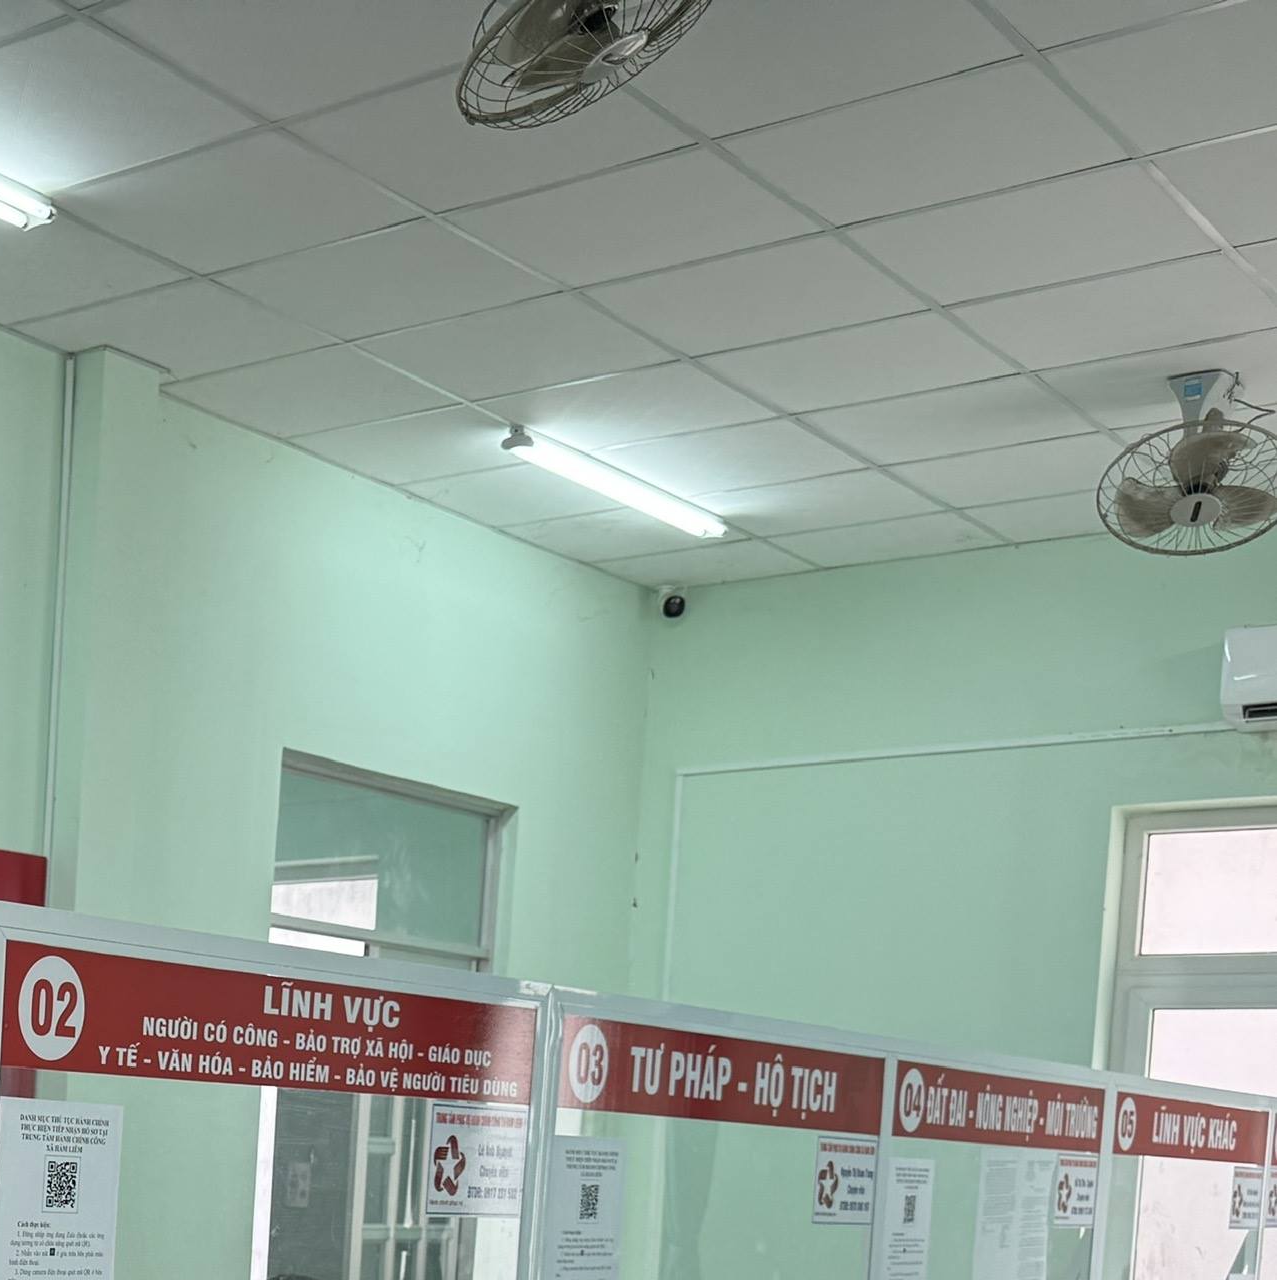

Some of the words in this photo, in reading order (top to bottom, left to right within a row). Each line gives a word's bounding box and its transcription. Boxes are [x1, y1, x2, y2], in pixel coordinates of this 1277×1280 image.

[31, 979, 78, 1037] 02
[263, 982, 332, 1022] LĨNH
[343, 993, 400, 1034] VỰC
[143, 1015, 198, 1040] NGƯỜI
[204, 1017, 227, 1043] CÓ
[233, 1023, 278, 1047] CÔNG
[295, 1027, 325, 1052] BẢO
[332, 1036, 360, 1058] TRỢ
[365, 1035, 384, 1058] XÃ
[389, 1038, 414, 1063] HỘI
[428, 1039, 461, 1064] GIÁO
[464, 1048, 492, 1069] DỤC
[577, 1042, 604, 1085] 03
[98, 1046, 108, 1065] Y
[116, 1042, 138, 1066] TẾ
[157, 1049, 192, 1071] VĂN
[198, 1052, 234, 1075] HÓA
[252, 1057, 283, 1080] BẢO
[290, 1057, 329, 1082] HIỂM
[346, 1063, 376, 1087] BẢO
[380, 1066, 399, 1091] VỆ
[402, 1069, 445, 1092] NGƯỜI
[450, 1071, 479, 1095] TIÊU
[482, 1077, 517, 1097] DÙNG
[631, 1043, 665, 1095] TƯ
[668, 1044, 732, 1101] PHÁP
[754, 1053, 785, 1117] HỘ
[791, 1067, 837, 1120] TỊCH
[904, 1082, 923, 1118] 04
[926, 1073, 946, 1125] ĐẤT
[949, 1086, 968, 1128] ĐAI
[975, 1084, 1003, 1131] NÔNG
[1005, 1088, 1038, 1142] NGHIỆP
[1045, 1092, 1063, 1136] MÔI
[1065, 1096, 1098, 1139] TRƯỜNG
[1121, 1109, 1134, 1141] 05
[1152, 1104, 1179, 1145] LĨNH
[1183, 1112, 1205, 1153] VỰC
[1207, 1112, 1237, 1151] KHÁC
